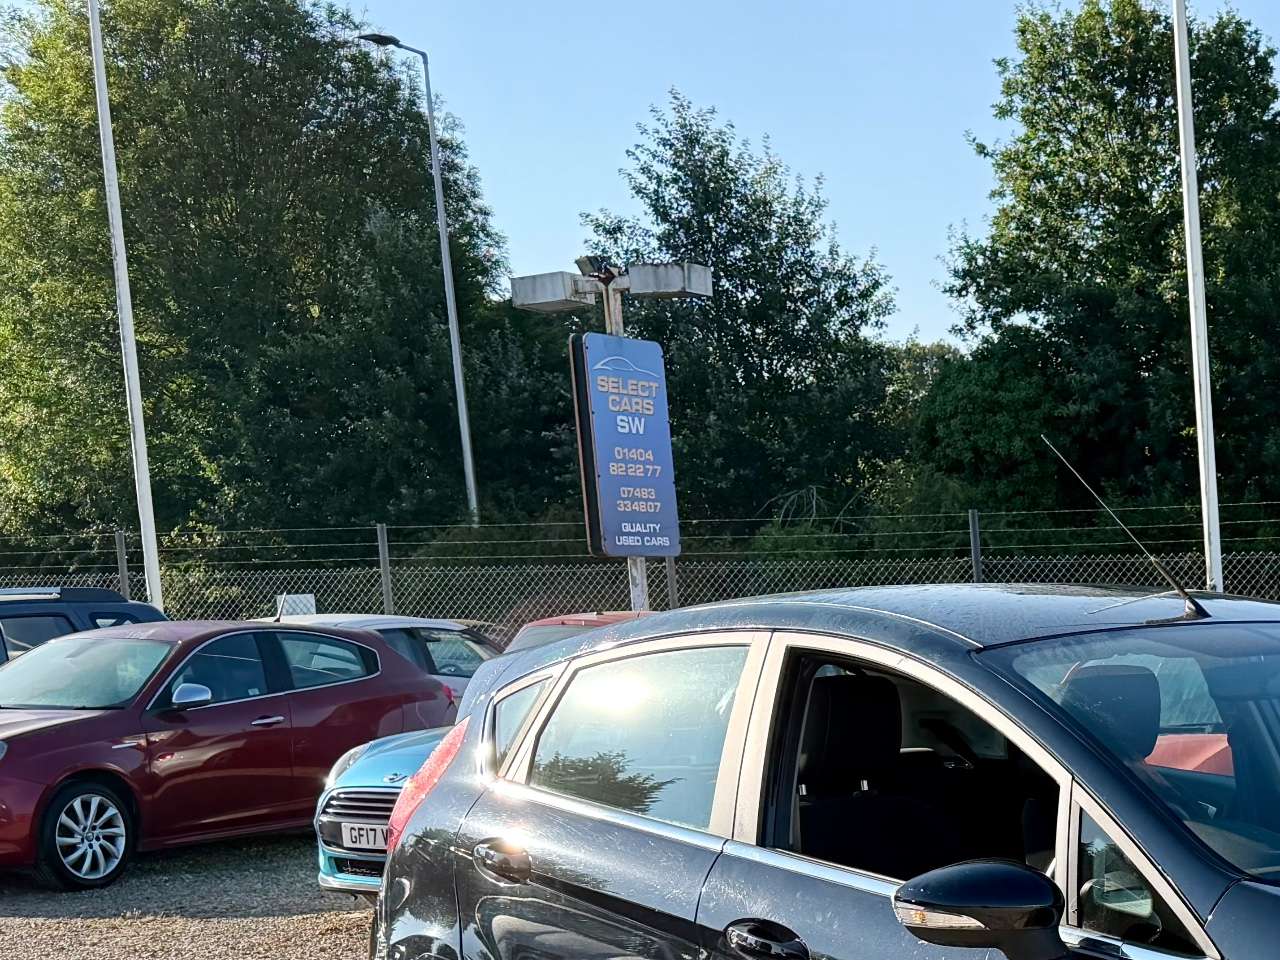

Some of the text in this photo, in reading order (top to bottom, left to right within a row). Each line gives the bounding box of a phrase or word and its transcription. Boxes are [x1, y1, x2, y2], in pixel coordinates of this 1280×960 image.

[597, 375, 659, 397] SELECT
[608, 395, 654, 415] CARS
[616, 415, 645, 435] SW
[615, 446, 654, 461] 01404
[621, 522, 661, 533] QUALITY
[616, 536, 670, 547] USED CARS
[350, 826, 377, 846] GF17
